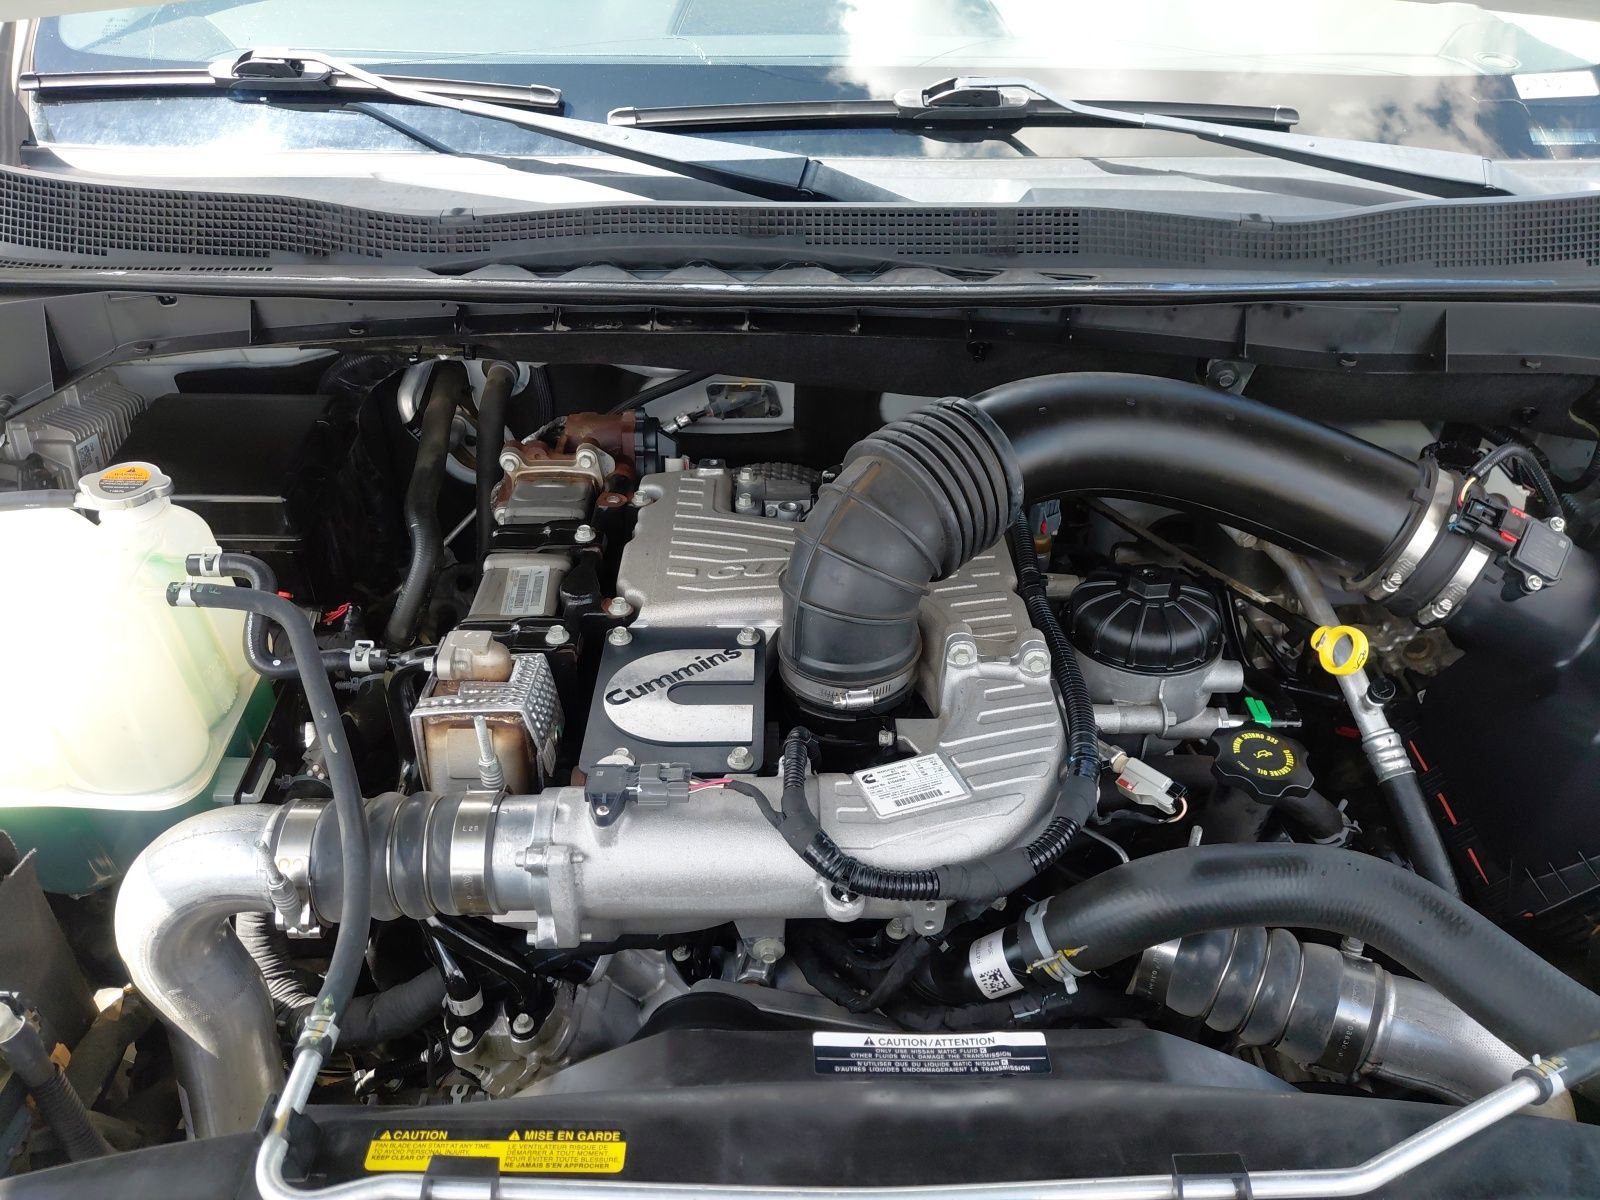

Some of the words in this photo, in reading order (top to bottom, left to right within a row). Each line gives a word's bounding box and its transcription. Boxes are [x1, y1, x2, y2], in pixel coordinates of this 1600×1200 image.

[605, 649, 742, 706] Cummins
[393, 1130, 448, 1140] CAUTION
[524, 1130, 554, 1140] MISE
[557, 1130, 574, 1140] EN
[577, 1130, 620, 1142] GARDE
